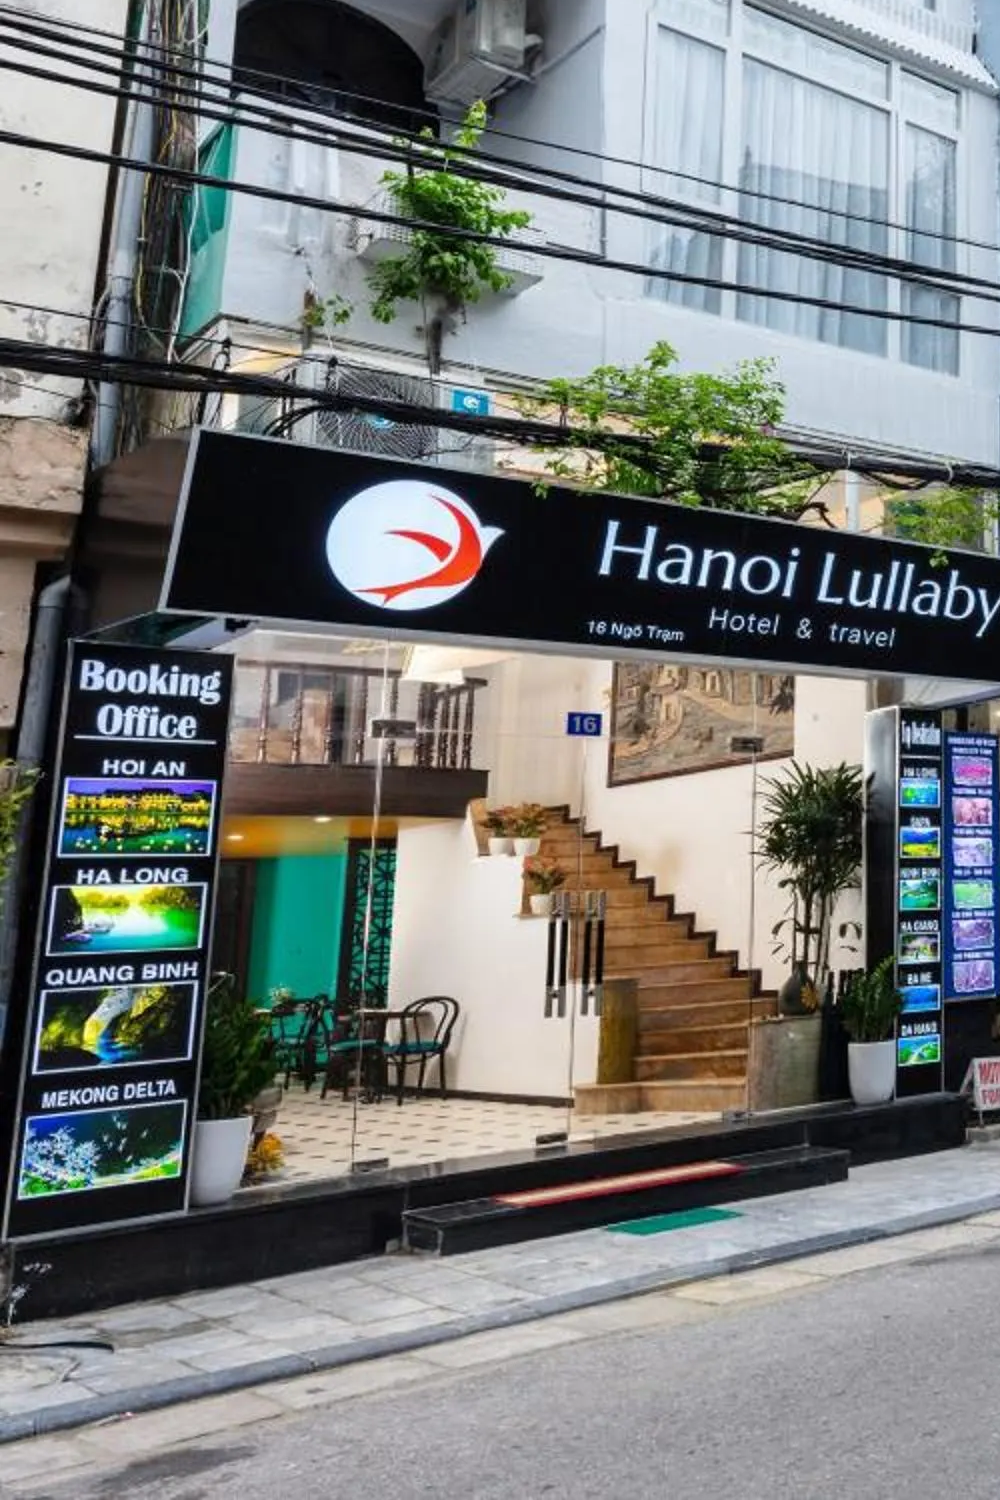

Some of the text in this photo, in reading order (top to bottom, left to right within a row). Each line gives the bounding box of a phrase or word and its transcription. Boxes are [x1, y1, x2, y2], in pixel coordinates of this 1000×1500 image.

[598, 520, 800, 597] Hanoi
[587, 620, 607, 635] 16
[708, 607, 896, 648] Hotel & travel
[79, 659, 221, 705] Booking
[97, 704, 198, 739] Office
[573, 715, 597, 733] 16
[102, 759, 186, 776] HOI AN
[76, 867, 189, 885] HA LONG
[46, 961, 199, 986] QUANG BINH
[42, 1079, 177, 1109] MEKONG DELTA
